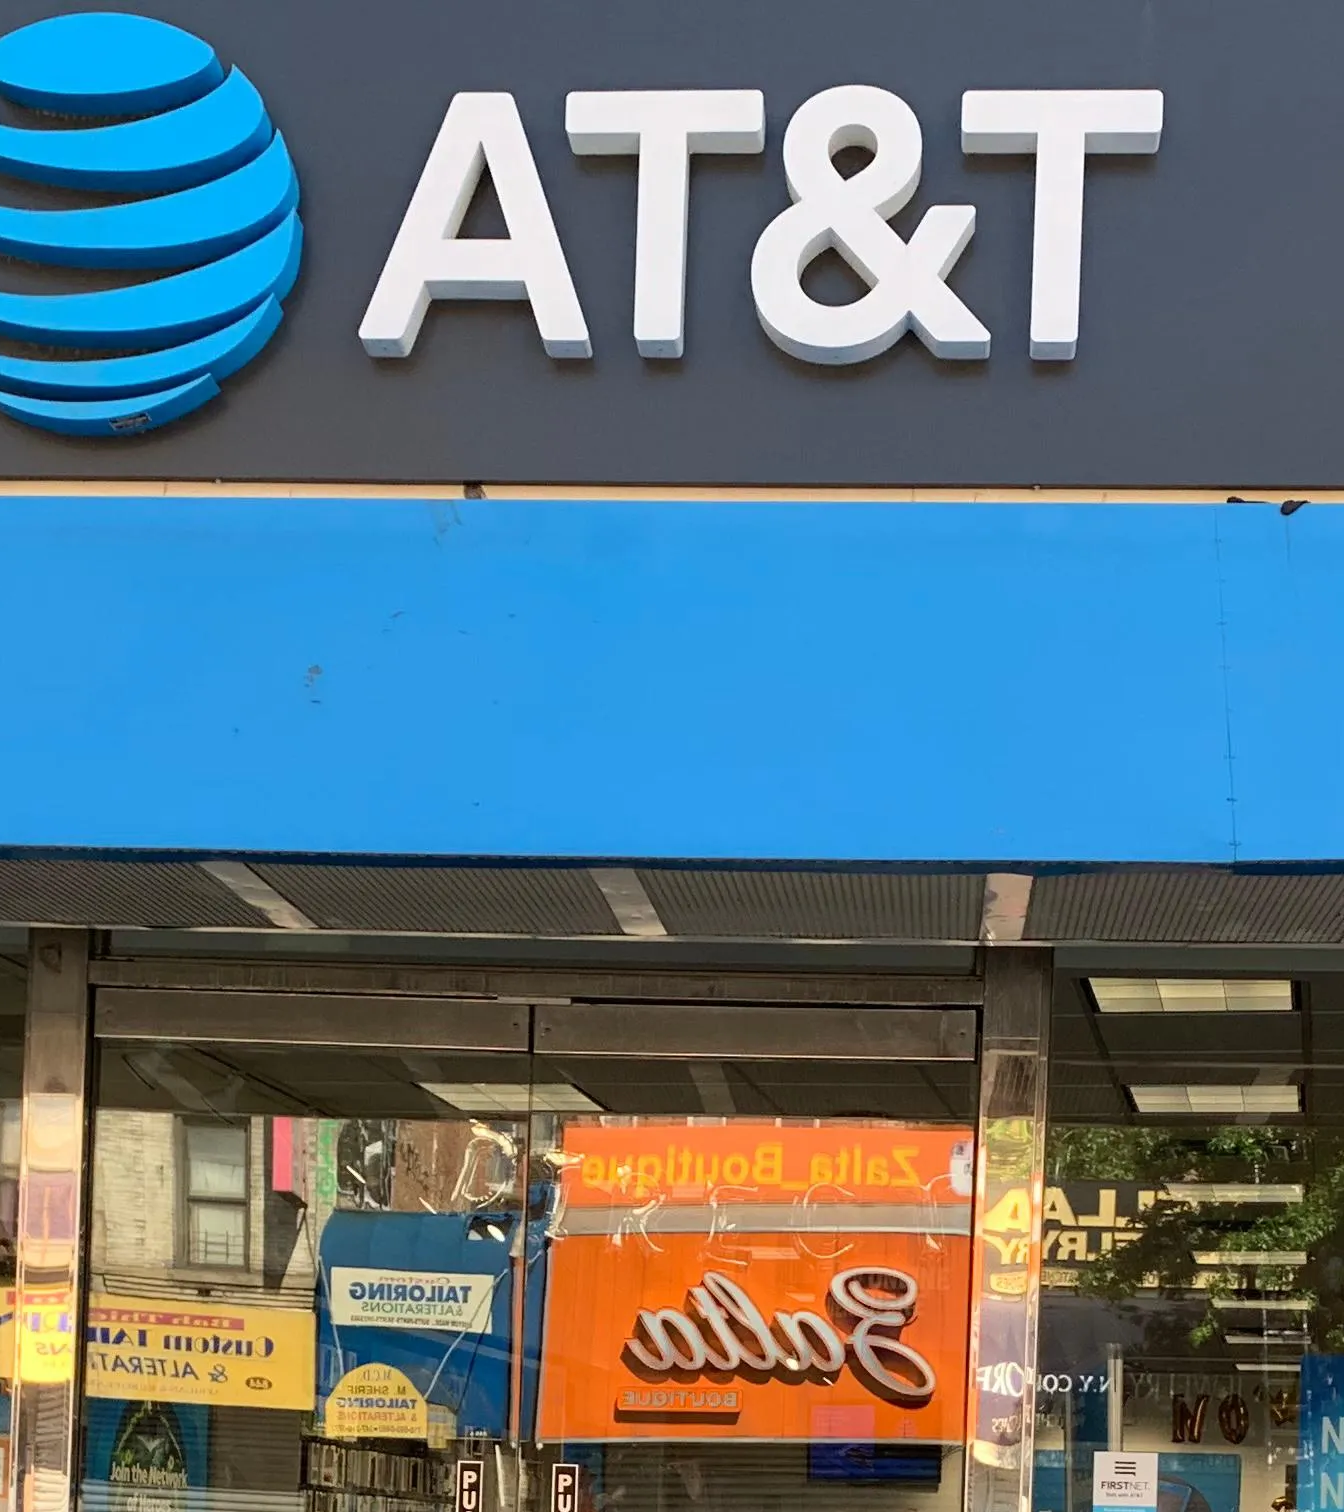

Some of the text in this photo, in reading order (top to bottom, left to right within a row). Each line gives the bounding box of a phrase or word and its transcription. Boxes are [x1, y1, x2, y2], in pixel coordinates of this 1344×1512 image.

[358, 84, 1164, 365] AT&T
[110, 1461, 131, 1482] Join
[131, 1462, 148, 1484] the
